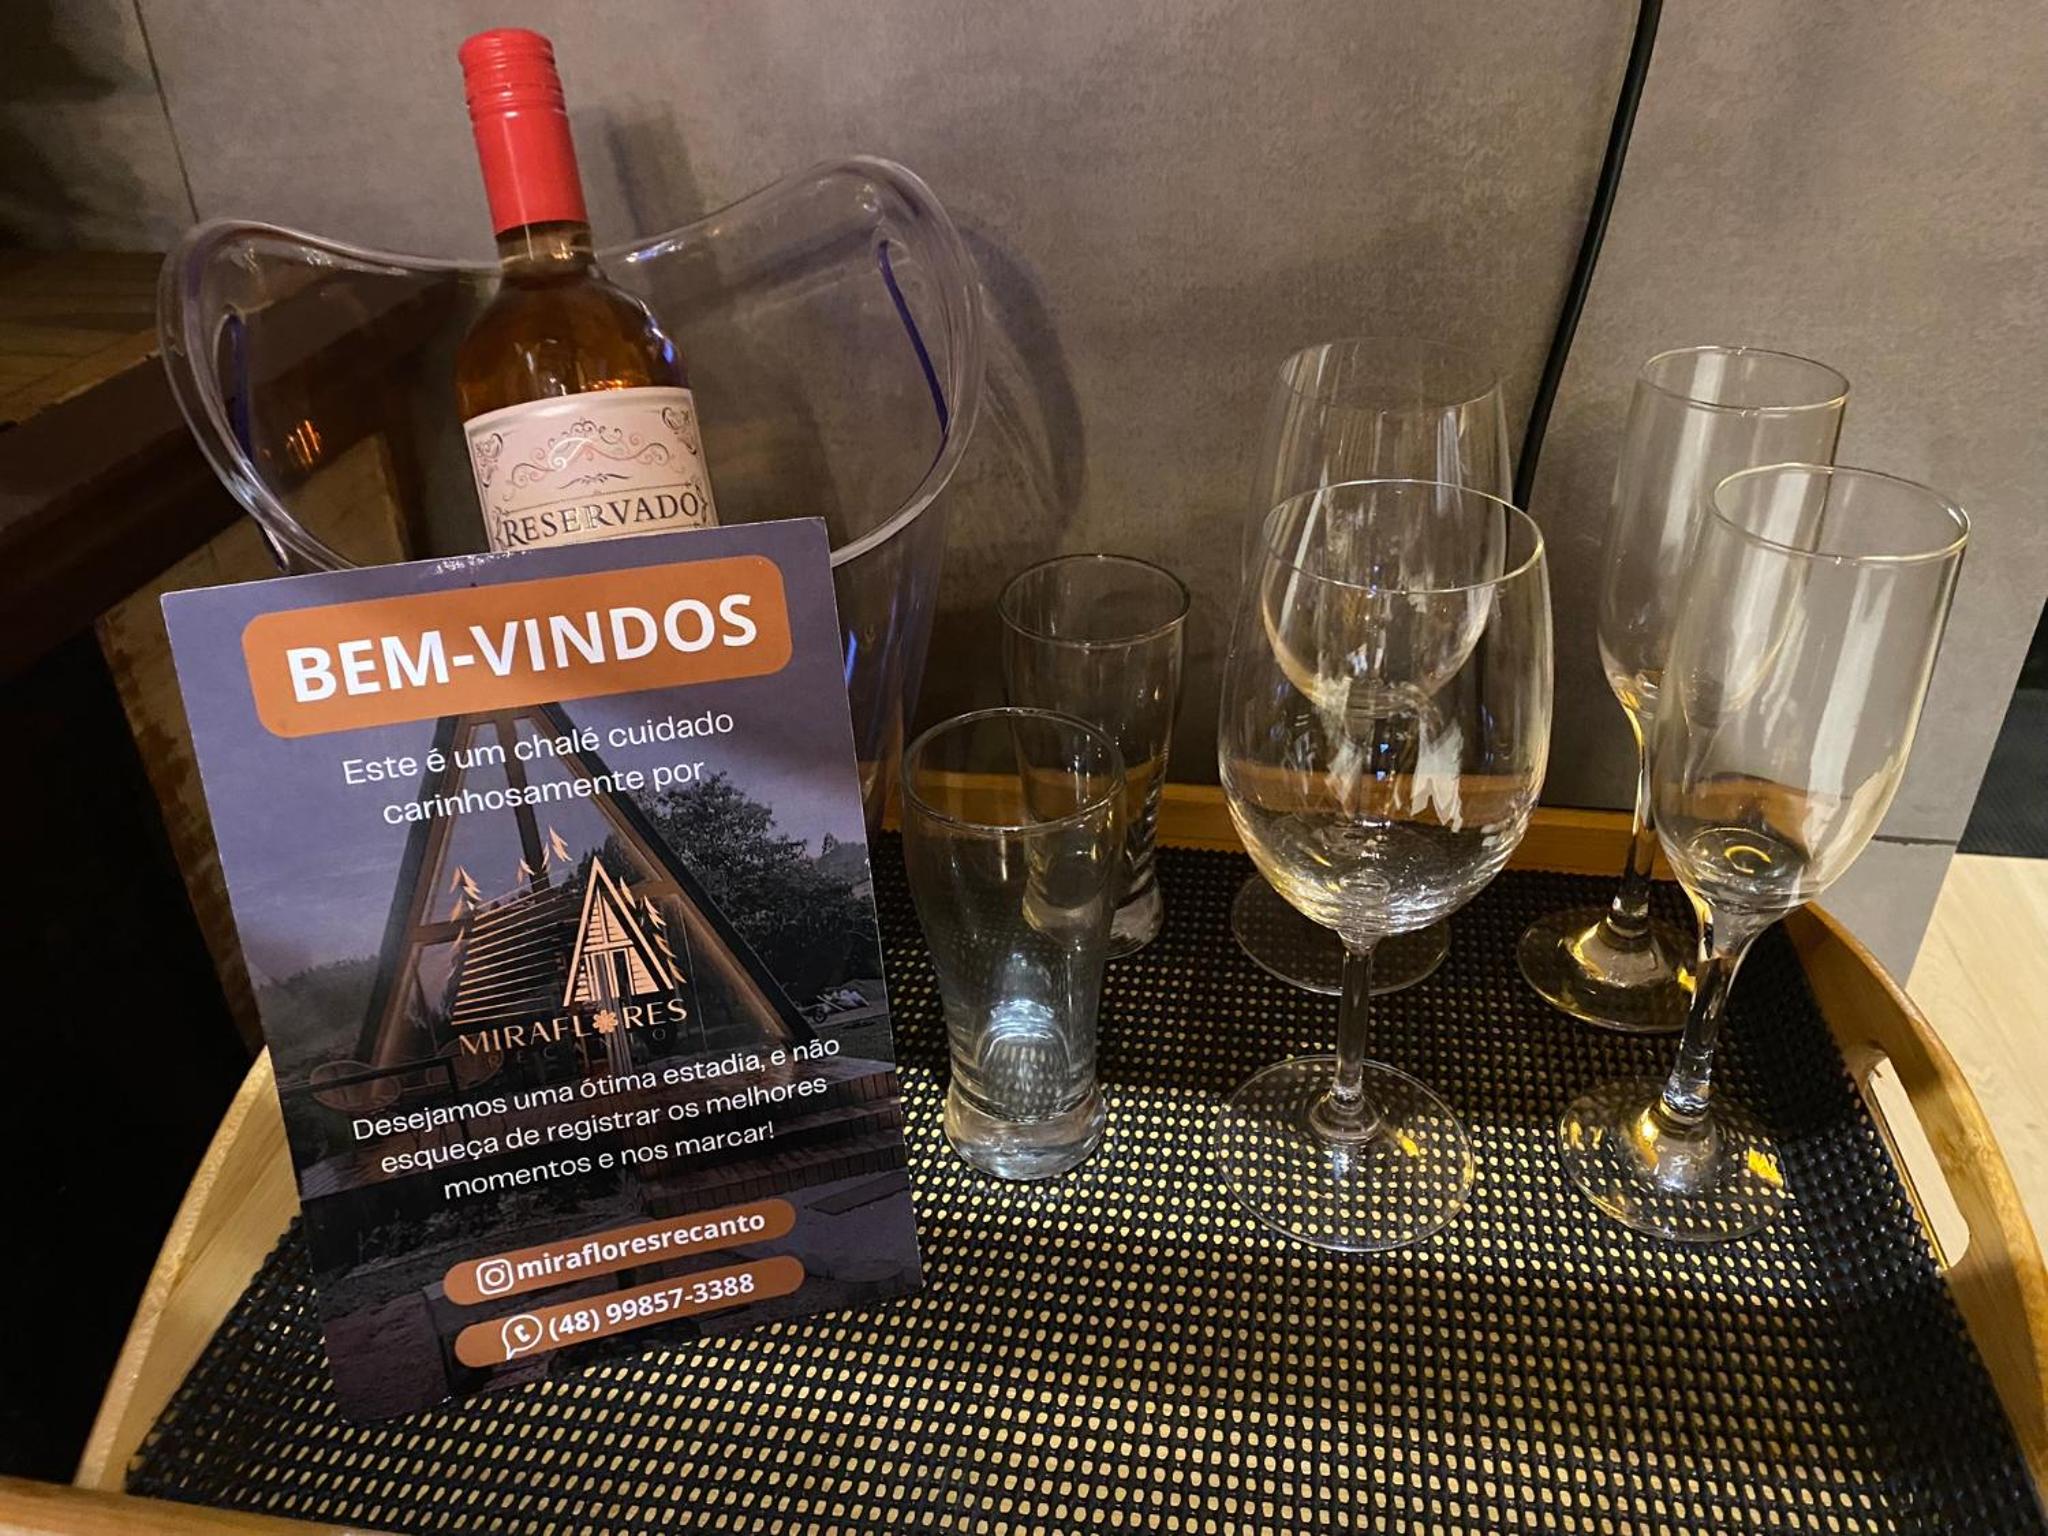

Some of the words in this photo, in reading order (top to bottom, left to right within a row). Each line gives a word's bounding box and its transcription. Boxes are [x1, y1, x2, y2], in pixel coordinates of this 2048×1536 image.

[502, 491, 699, 548] RESERVADO
[286, 593, 758, 702] BEM-VINDOS
[342, 755, 418, 786] Este
[426, 748, 446, 773] é
[455, 742, 506, 770] um
[514, 726, 600, 763] chalé
[608, 710, 735, 749] cuidado
[383, 768, 645, 825] carinhosamente
[652, 761, 704, 793] por
[353, 1095, 508, 1141] Desejamos
[513, 1084, 574, 1111] uma
[580, 1070, 657, 1100] ótima
[663, 1054, 766, 1087] estadia,
[771, 1051, 787, 1068] e
[793, 1037, 840, 1062] não
[381, 1136, 500, 1174] esqueça
[506, 1123, 540, 1148] de
[546, 1105, 661, 1147] registrar
[668, 1101, 700, 1122] os
[706, 1074, 828, 1116] melhores
[444, 1156, 592, 1200] momentos
[598, 1151, 614, 1169] e
[621, 1142, 669, 1166] nos
[675, 1120, 775, 1159] marcar!
[517, 1213, 766, 1281] mirafloresrecanto
[549, 1309, 600, 1342] (48)
[606, 1273, 755, 1325] 99857-3388
